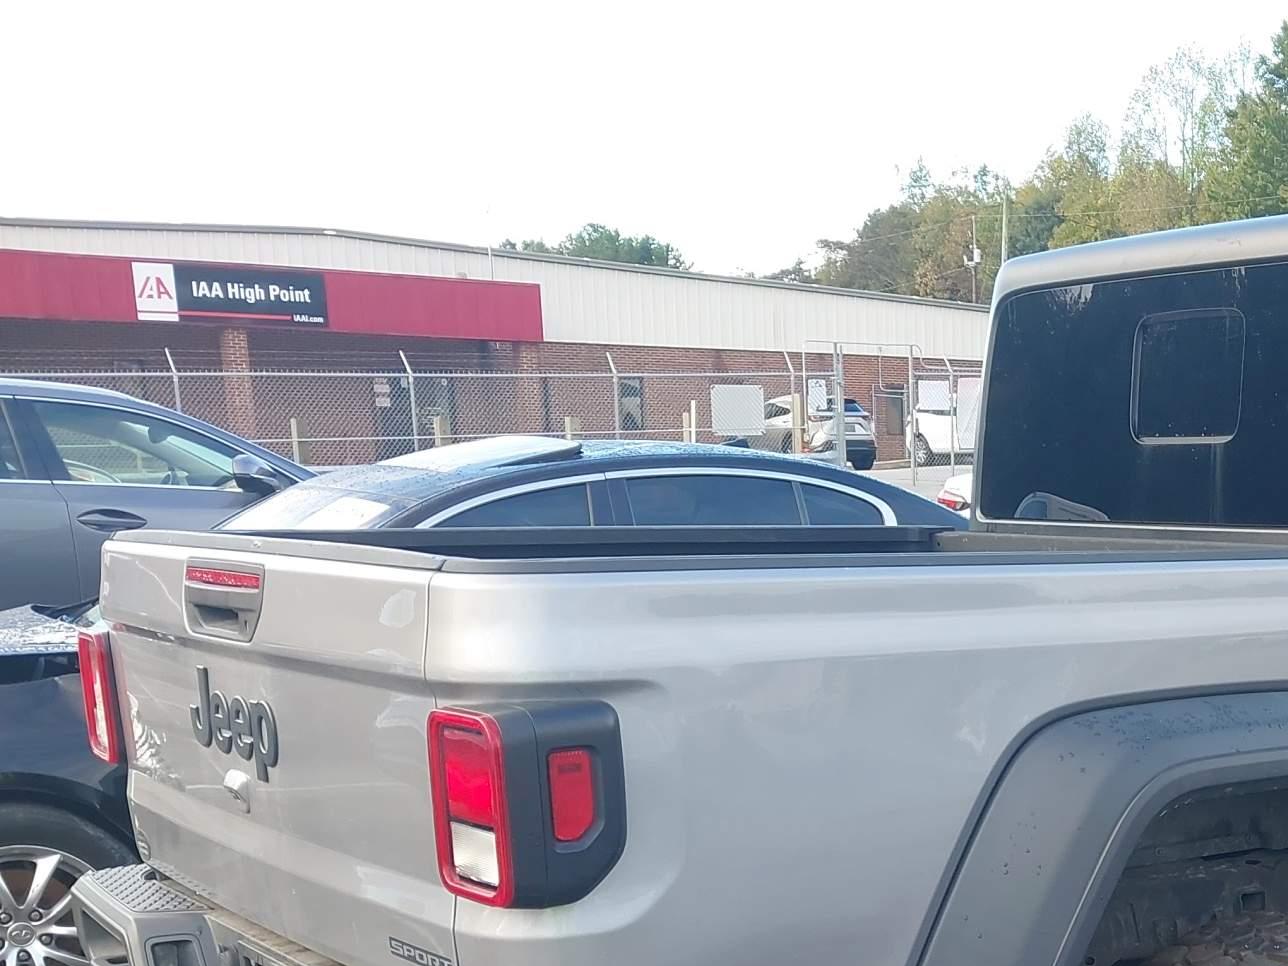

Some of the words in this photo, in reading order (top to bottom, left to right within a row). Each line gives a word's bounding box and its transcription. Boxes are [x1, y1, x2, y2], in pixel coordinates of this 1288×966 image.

[191, 280, 224, 299] IAA
[227, 283, 266, 304] High
[269, 285, 311, 303] Point
[189, 664, 279, 784] Jeep
